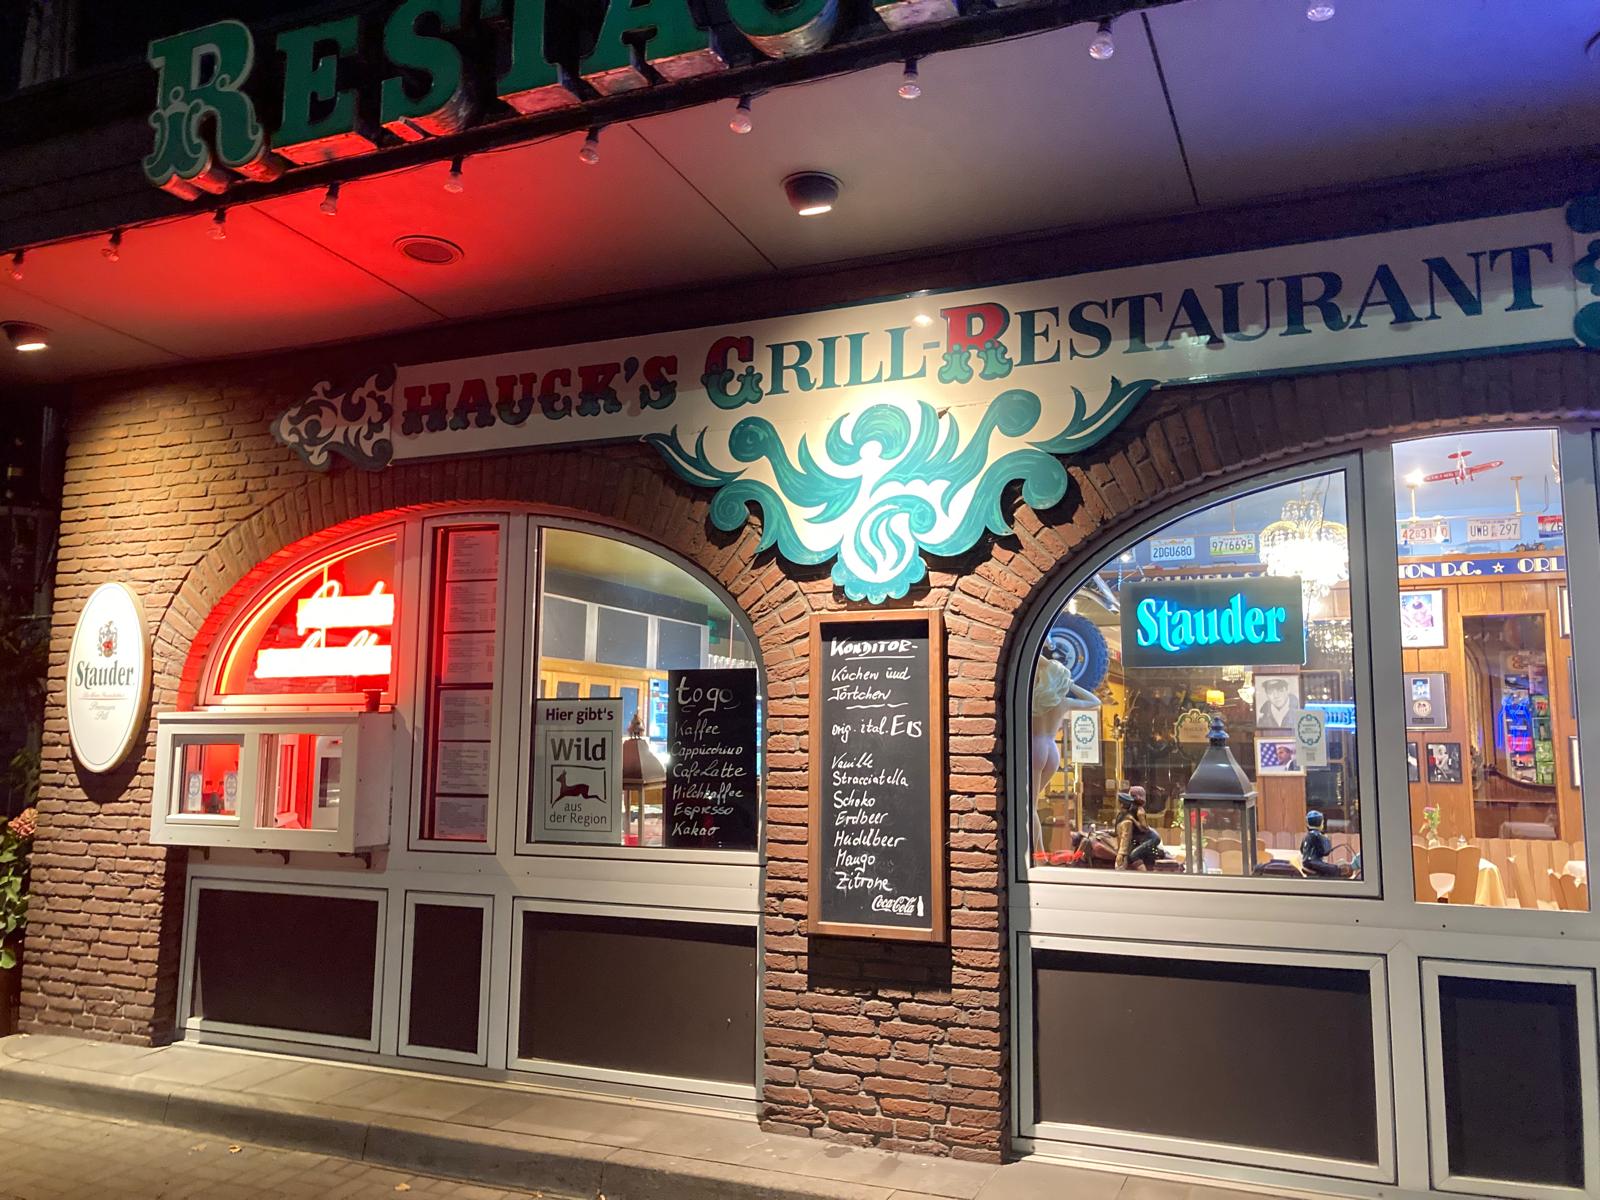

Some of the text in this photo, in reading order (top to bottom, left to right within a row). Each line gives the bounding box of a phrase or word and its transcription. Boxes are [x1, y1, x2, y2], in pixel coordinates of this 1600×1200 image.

[400, 354, 678, 435] HAUCK'S
[1441, 560, 1482, 577] D.C.
[1136, 592, 1286, 652] Stauder
[75, 660, 134, 690] Stauder
[545, 707, 614, 724] Hier gibt's
[550, 737, 606, 761] Wild
[832, 769, 909, 787] Stracciatella
[564, 802, 582, 812] aus
[833, 789, 876, 809] Schoko
[549, 812, 607, 827] der Region
[835, 808, 888, 826] Erdbeer
[835, 870, 893, 891] Zitrone
